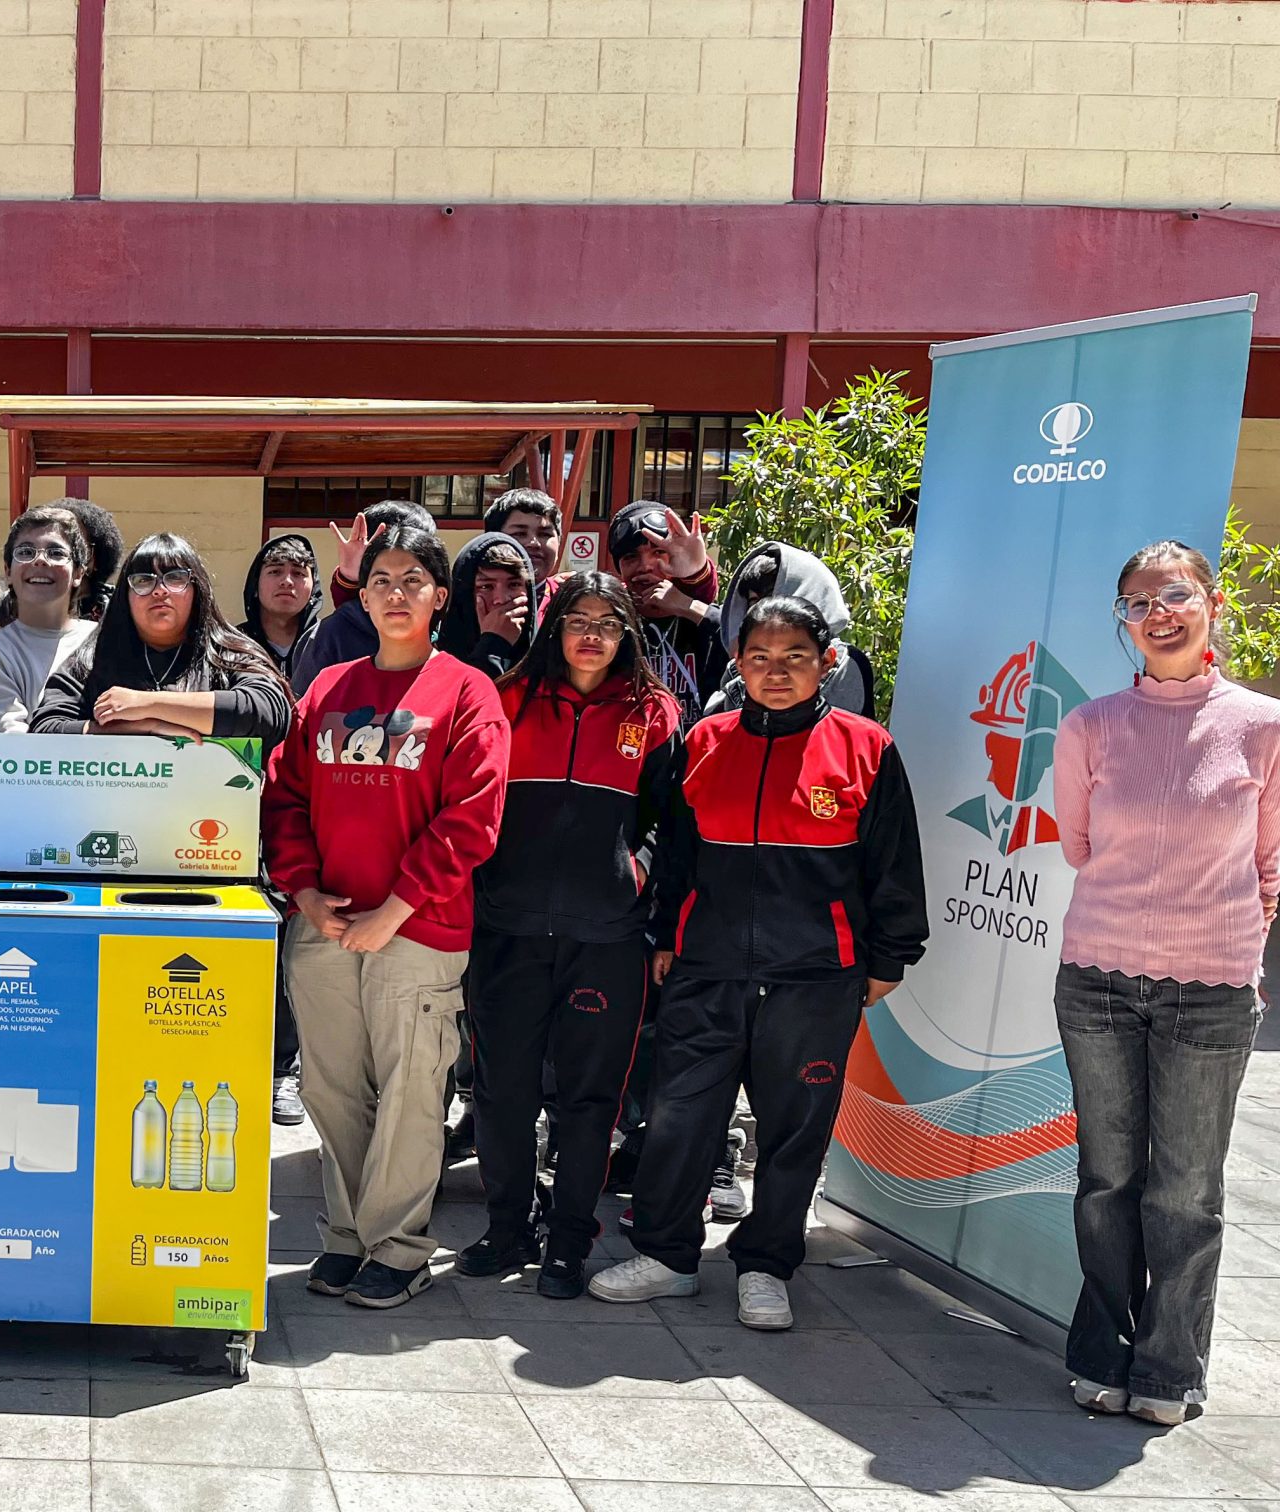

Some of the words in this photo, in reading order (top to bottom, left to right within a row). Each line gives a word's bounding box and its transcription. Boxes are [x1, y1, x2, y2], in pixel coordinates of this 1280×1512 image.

[1013, 459, 1107, 484] CODELCO
[639, 653, 697, 694] NBA
[25, 760, 52, 776] DE
[58, 760, 174, 778] RECICLAJE
[332, 772, 402, 787] MICKEY
[174, 848, 242, 861] CODELCO
[211, 863, 237, 871] Mistral
[965, 859, 1038, 907] PLAN
[944, 898, 1049, 948] SPONSOR
[147, 986, 225, 1001] BOTELLAS
[144, 1000, 227, 1017] PLÁSTICAS
[11, 1016, 53, 1024] CUADERNOS
[161, 1028, 209, 1036] DESECHABLES
[154, 1235, 229, 1246] DEGRADACIÓN
[5, 1245, 11, 1254] 1
[34, 1246, 55, 1255] Año
[167, 1252, 188, 1262] 150
[203, 1254, 230, 1263] Años
[187, 1310, 239, 1321] environment
